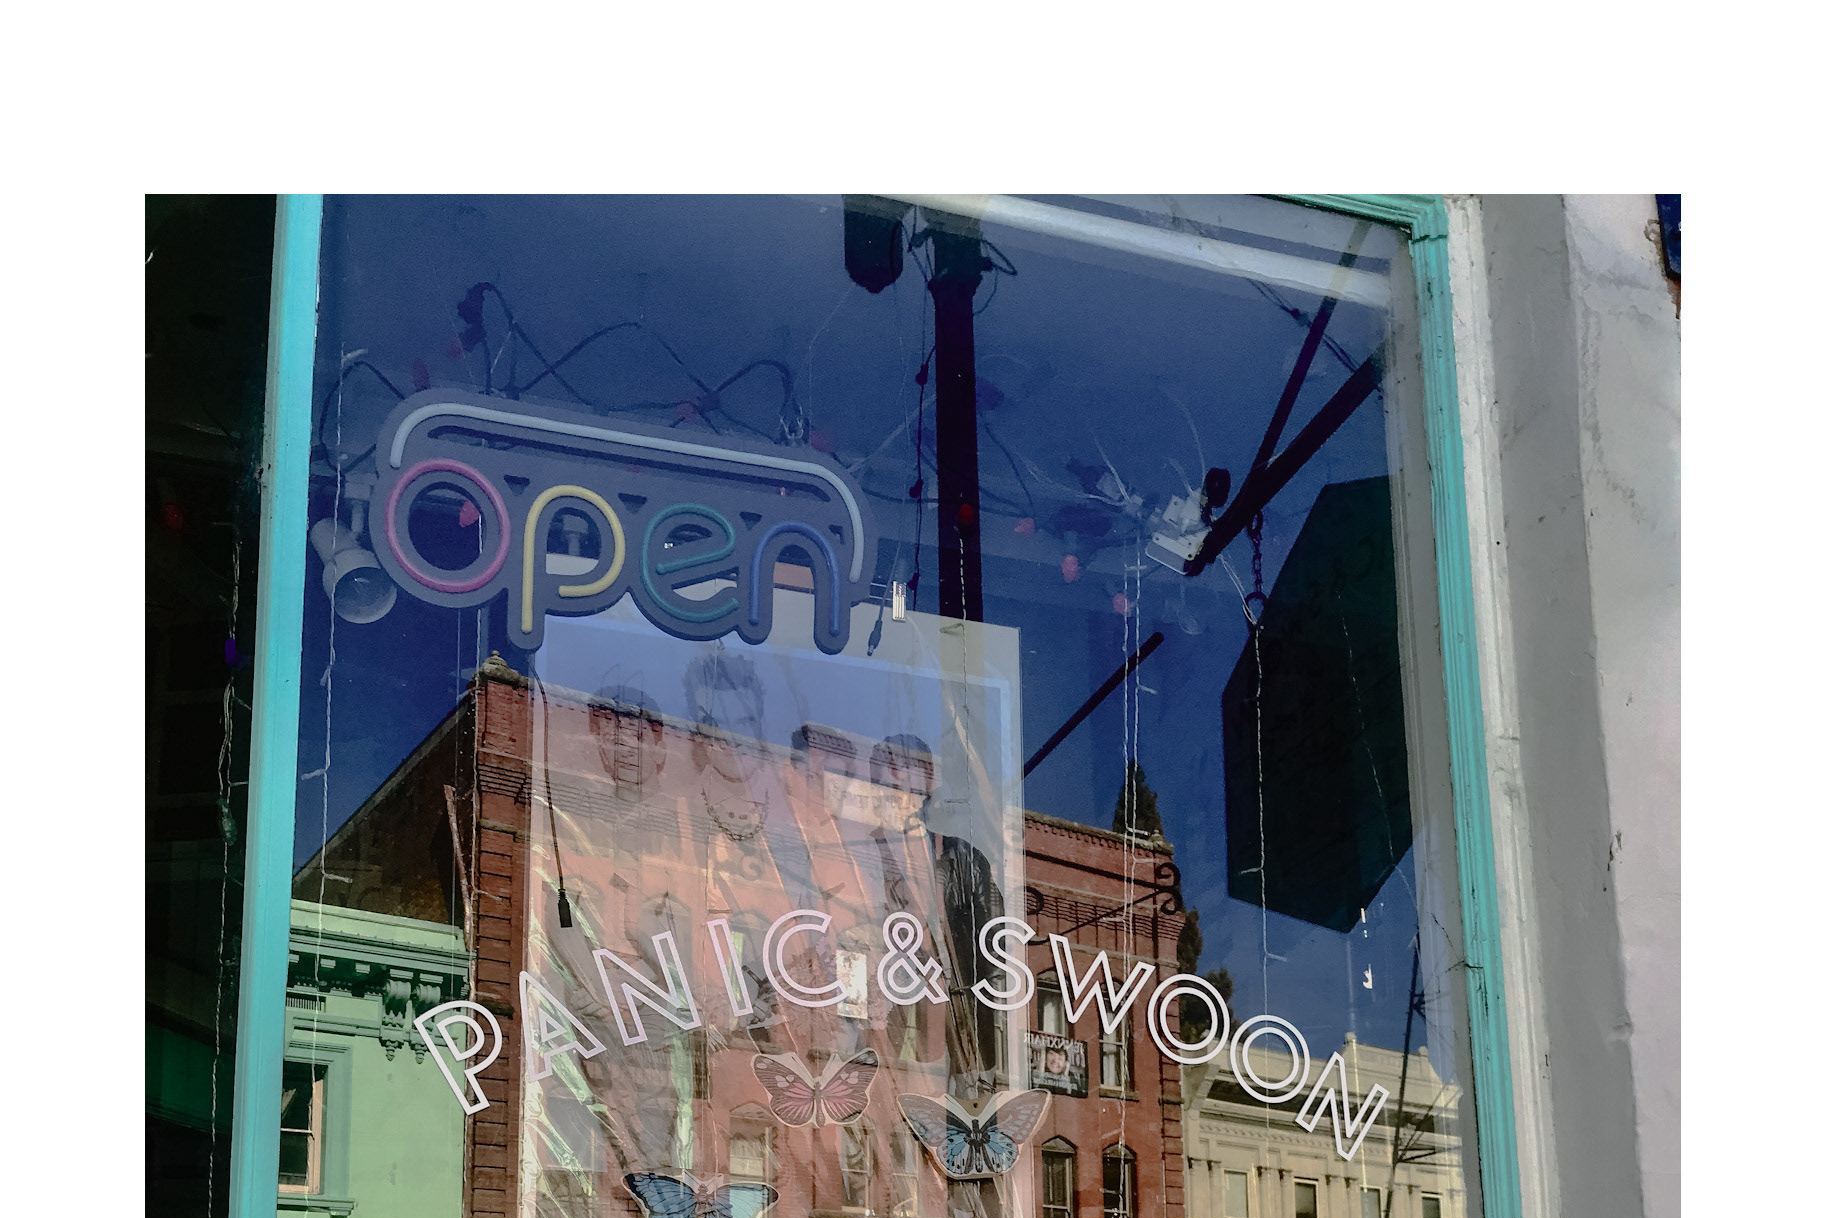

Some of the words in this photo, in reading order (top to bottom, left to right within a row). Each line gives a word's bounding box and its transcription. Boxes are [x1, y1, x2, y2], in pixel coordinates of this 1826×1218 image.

[414, 909, 847, 1115] PANIC
[877, 911, 950, 1006] &
[971, 916, 1390, 1162] SWOON
